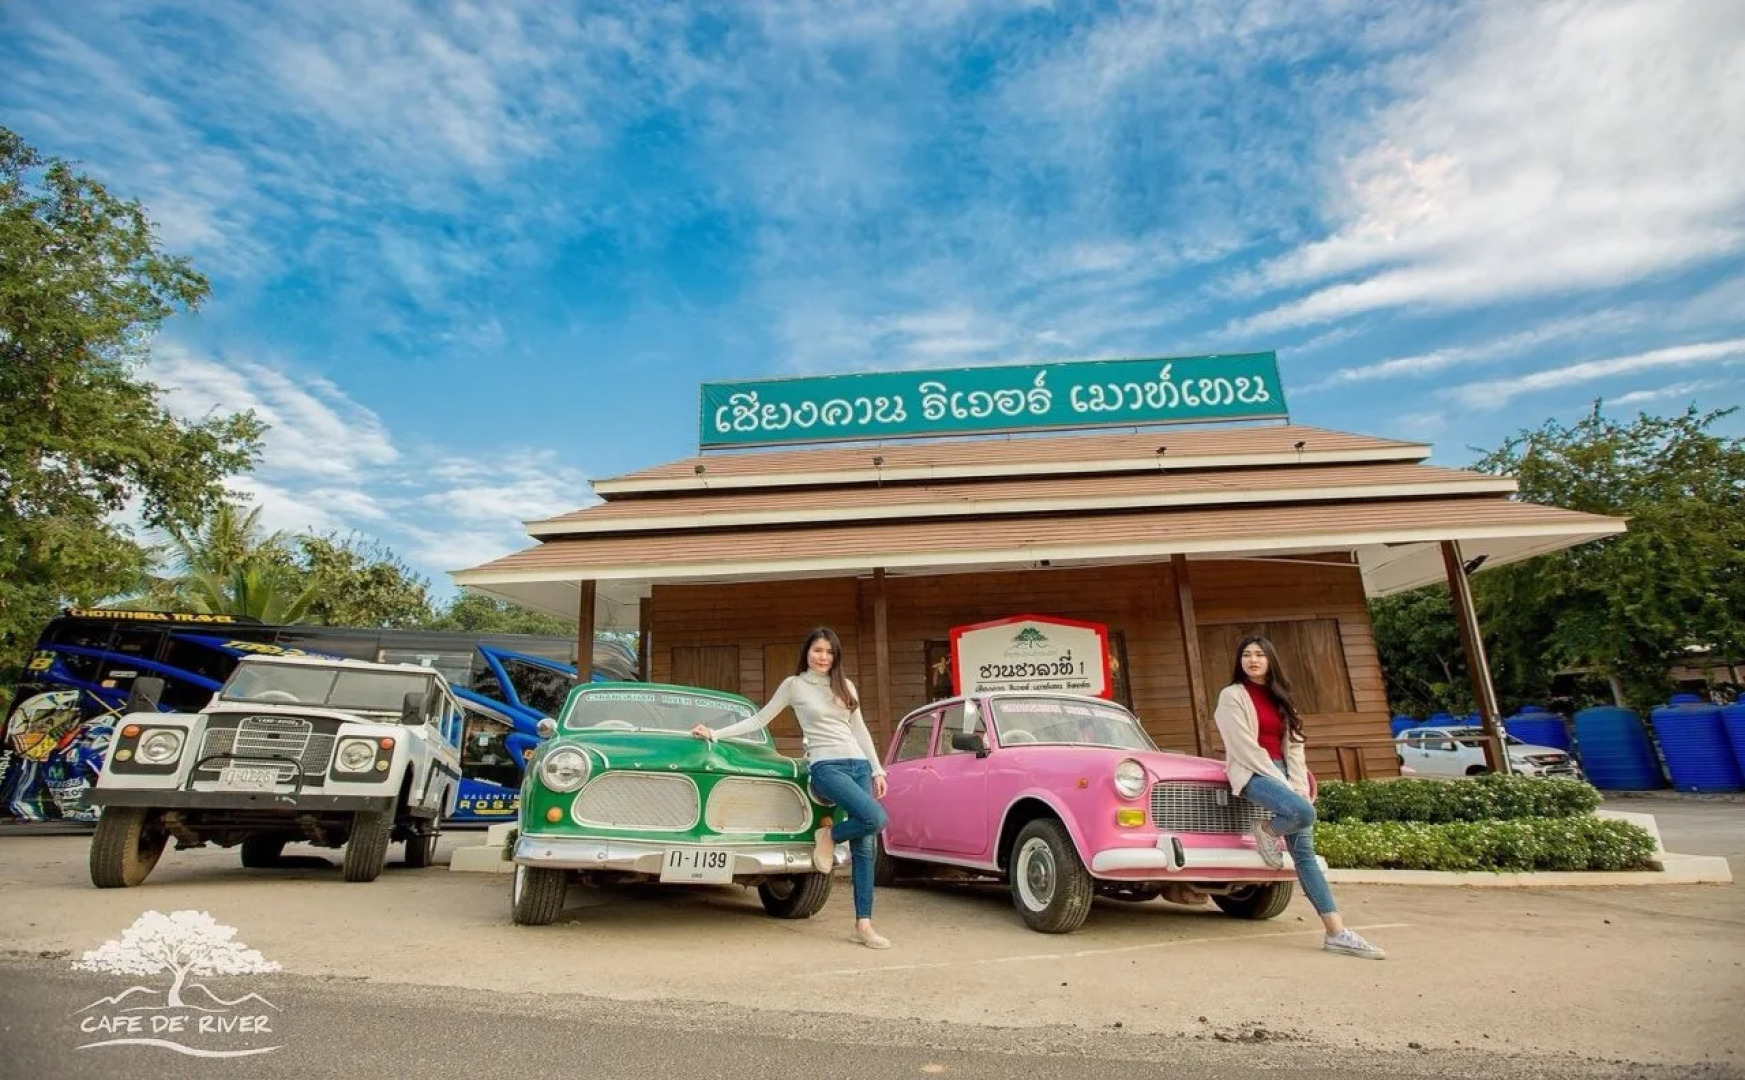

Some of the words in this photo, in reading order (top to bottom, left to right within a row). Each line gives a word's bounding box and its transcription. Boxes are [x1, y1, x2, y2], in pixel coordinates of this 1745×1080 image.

[715, 391, 908, 433] เชียงคาน
[918, 369, 1053, 421] ริเวอร์
[1069, 363, 1271, 413] เมาท์เทน
[172, 613, 237, 624] TRAVEL
[979, 649, 1075, 679] ชานชาลาที่
[459, 800, 521, 810] ROSS
